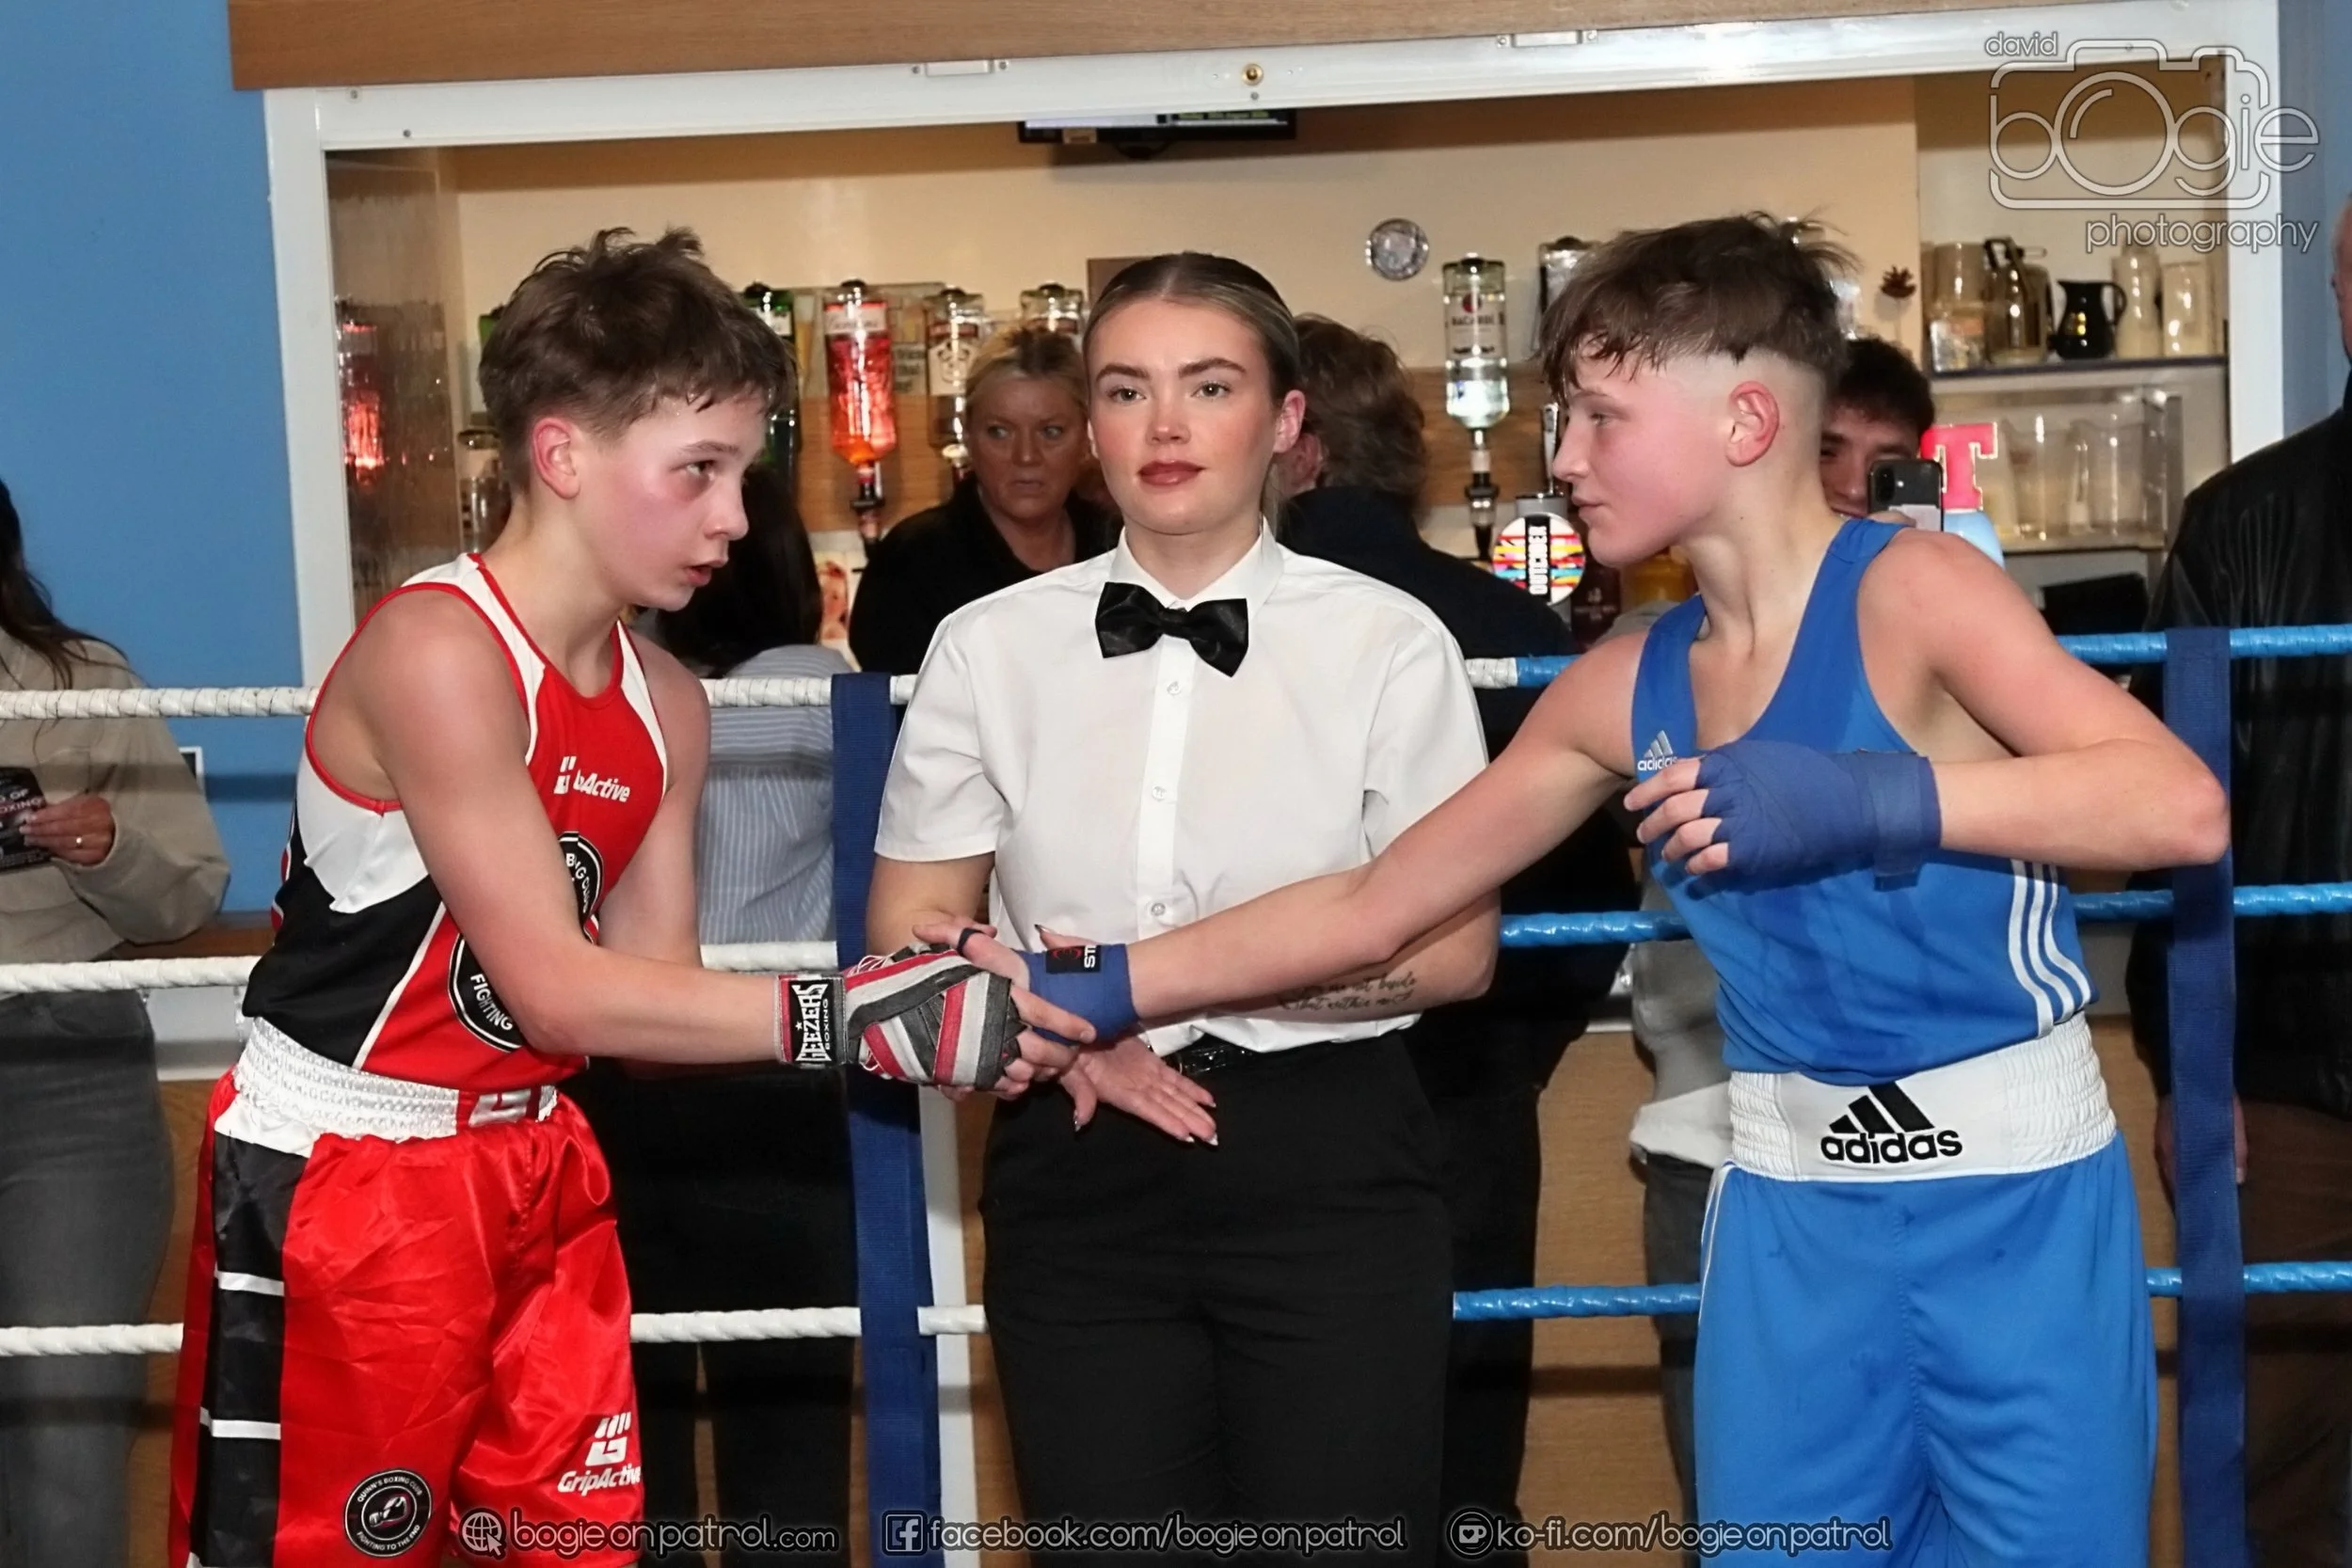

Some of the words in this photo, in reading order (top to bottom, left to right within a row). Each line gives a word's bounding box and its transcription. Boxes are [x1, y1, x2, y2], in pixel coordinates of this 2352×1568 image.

[470, 973, 513, 1031] FIGHTING
[791, 983, 832, 1062] GEEZERS
[822, 998, 831, 1051] BOXING
[1820, 1130, 1963, 1164] adidas
[358, 1480, 383, 1502] QUINN'S
[383, 1476, 410, 1485] BOXING
[398, 1537, 410, 1547] THE
[409, 1524, 421, 1539] END
